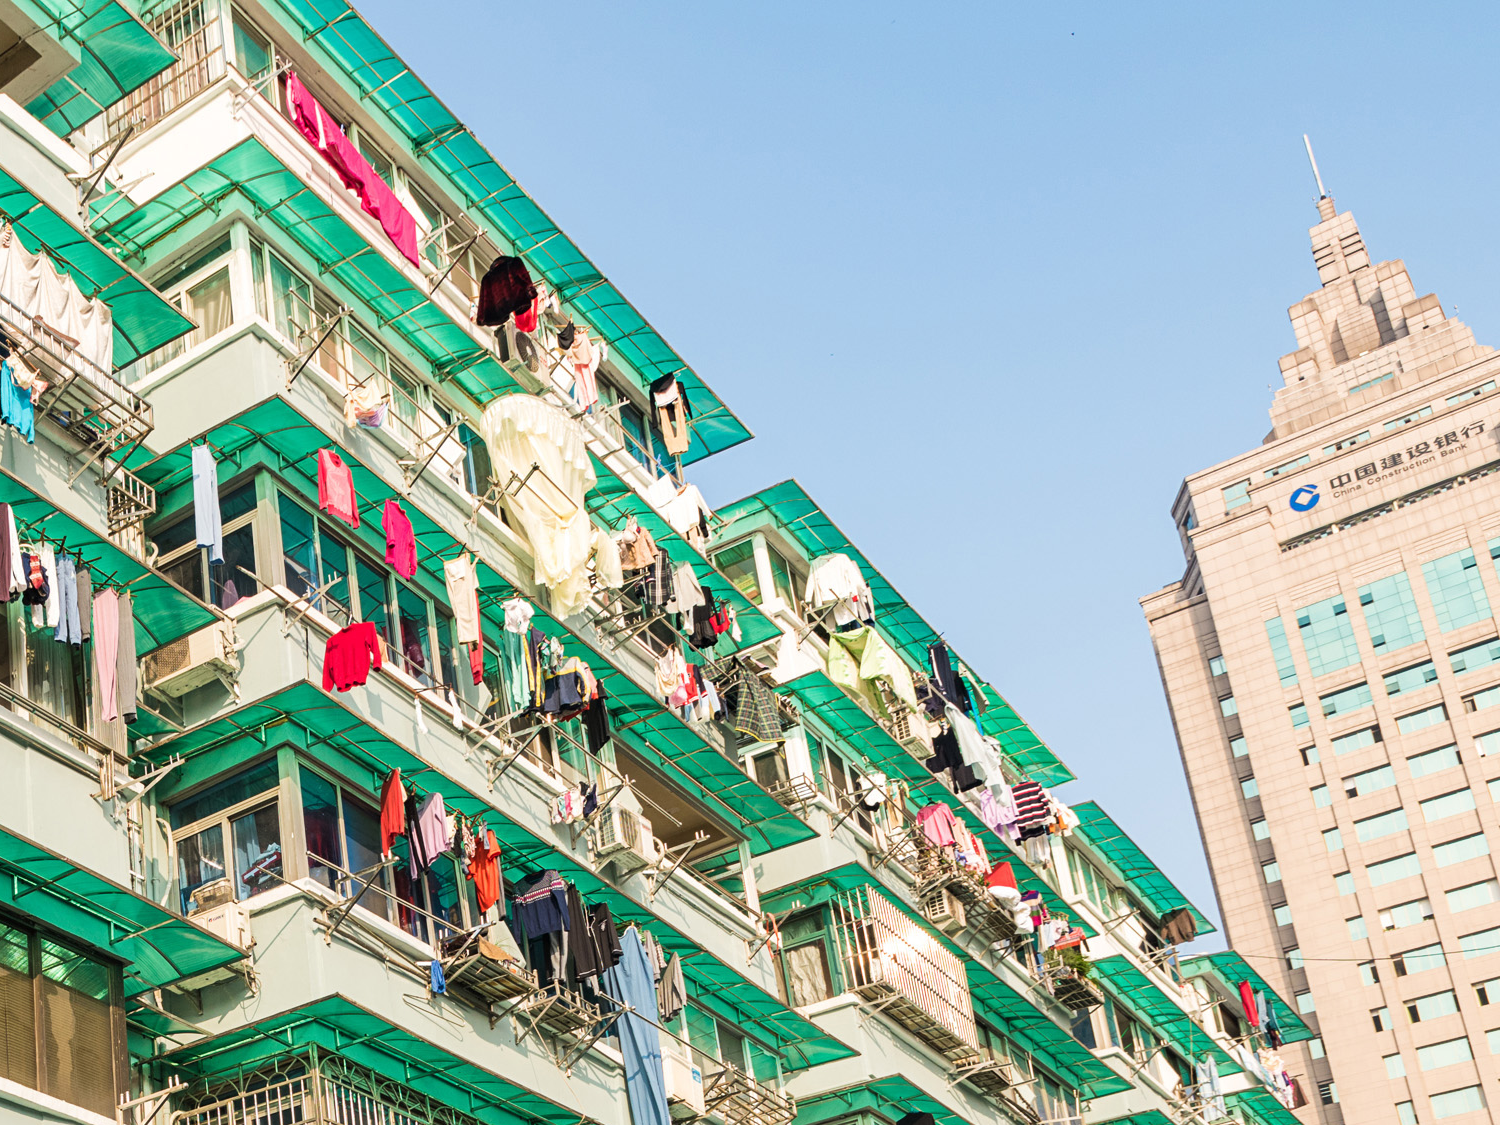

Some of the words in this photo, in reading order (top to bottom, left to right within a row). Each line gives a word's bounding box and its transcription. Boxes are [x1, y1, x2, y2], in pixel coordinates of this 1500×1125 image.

[1330, 420, 1485, 489] 中国建设银行
[1333, 484, 1361, 498] China
[1367, 455, 1435, 485] Construction
[1441, 442, 1468, 457] Bank
